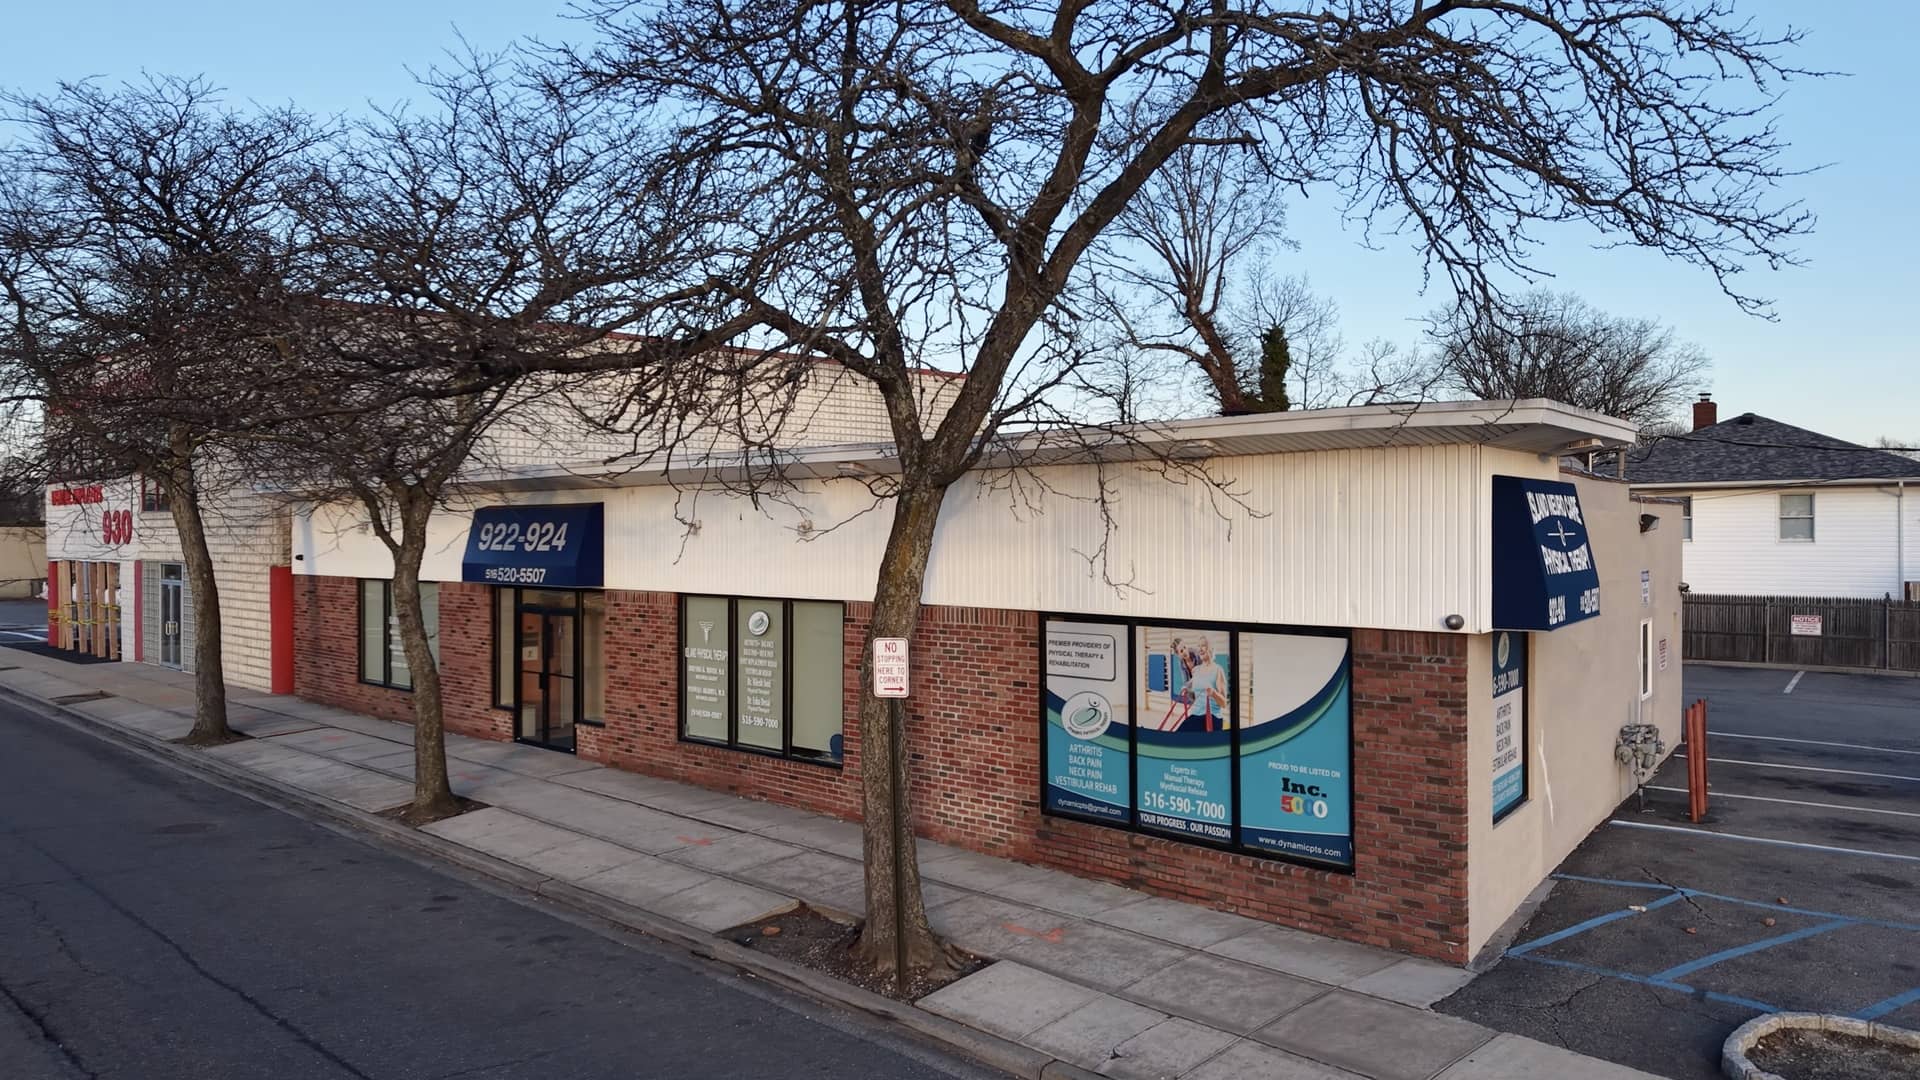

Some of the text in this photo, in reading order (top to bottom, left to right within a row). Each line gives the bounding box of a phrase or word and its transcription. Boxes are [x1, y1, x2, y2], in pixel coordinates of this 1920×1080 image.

[103, 509, 133, 545] 930
[478, 522, 568, 551] 922-924
[497, 567, 546, 583] 520-5507
[885, 642, 896, 653] NO
[1072, 641, 1101, 649] PROVIDERS
[1048, 650, 1073, 658] PHYSICAL
[1074, 651, 1099, 659] THERAPY
[877, 667, 895, 675] HERE
[1049, 660, 1090, 669] REHABILITATION
[880, 676, 904, 684] CORNER
[1069, 744, 1103, 757] ARTHRITIS
[1068, 755, 1102, 768] BACK PAIN
[1170, 764, 1190, 775] Experts
[1068, 766, 1102, 780] NECK PAIN
[1268, 762, 1341, 778] PROUD TO BE LISTED ON
[1055, 775, 1118, 794] VESTIBULAR REHAB
[1160, 781, 1208, 797] Myofascial Release
[1164, 773, 1205, 789] Manual Therapy
[1281, 777, 1327, 798] Inc.
[1144, 791, 1225, 820] 516-590-7000
[1281, 795, 1328, 819] 5000
[1140, 813, 1156, 824] YOUR
[1157, 816, 1186, 830] PROGRESS
[1190, 823, 1203, 834] OUR
[1204, 825, 1231, 839] PASSION
[1258, 836, 1342, 857] www.dynamicpts.com
